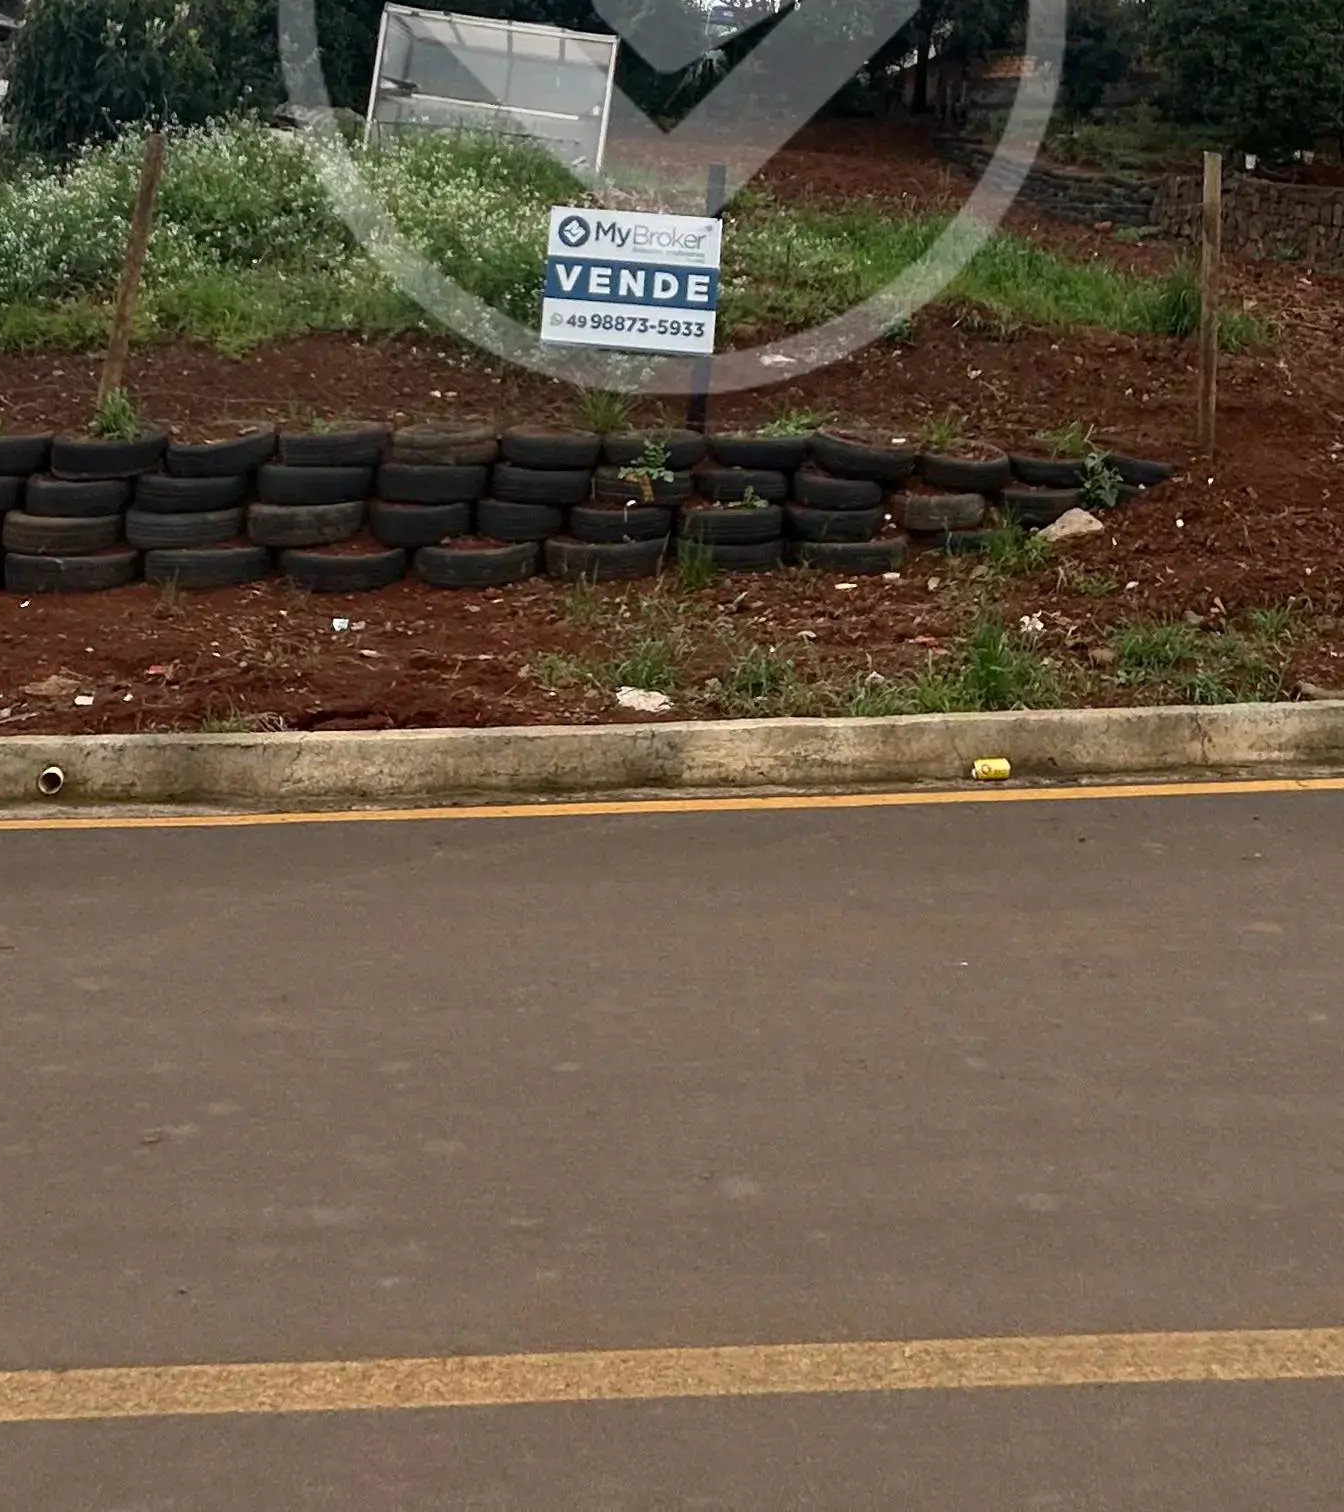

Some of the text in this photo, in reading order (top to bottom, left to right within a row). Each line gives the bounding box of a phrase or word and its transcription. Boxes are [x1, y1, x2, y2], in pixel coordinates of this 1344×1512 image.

[595, 220, 706, 249] MyBroker
[556, 264, 709, 301] VENDE
[566, 313, 705, 337] 49 98873-5933
